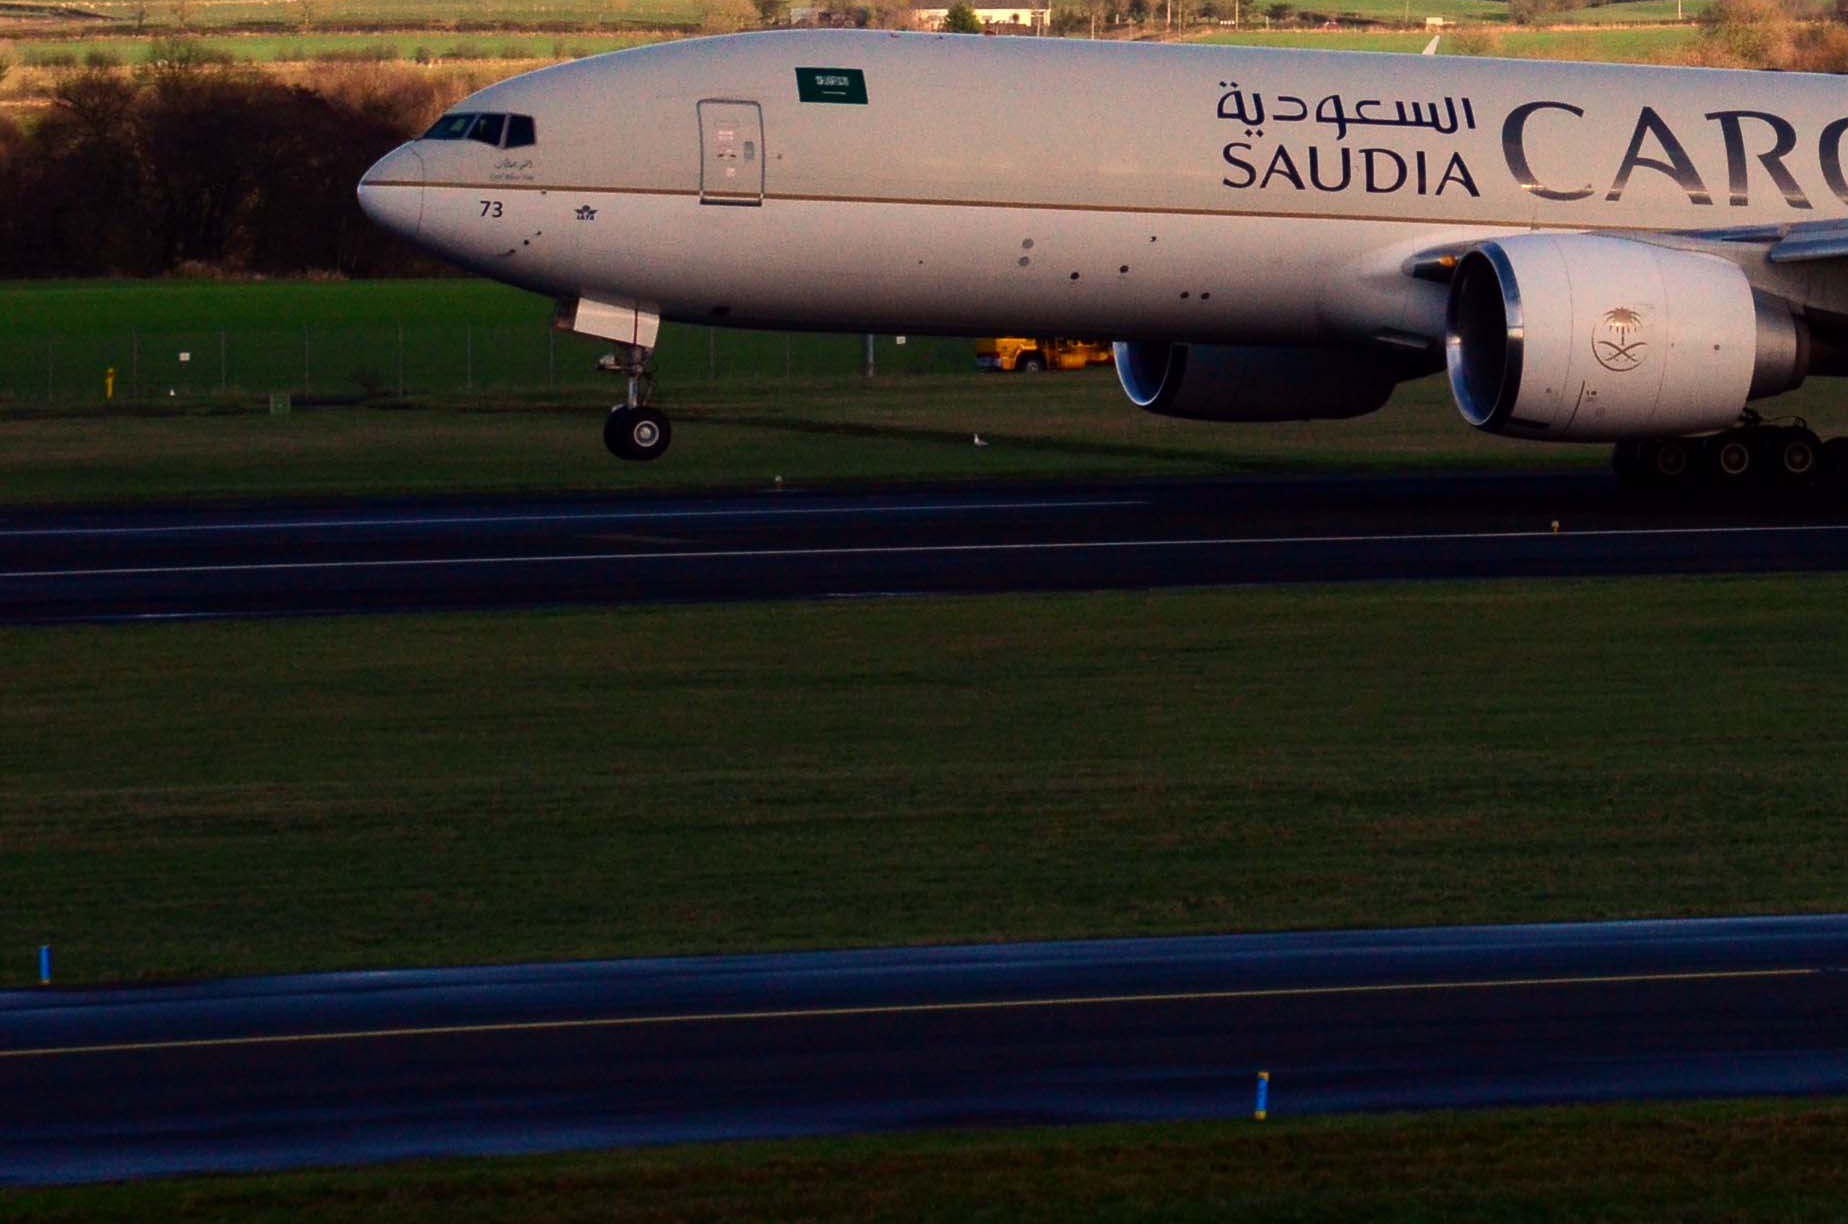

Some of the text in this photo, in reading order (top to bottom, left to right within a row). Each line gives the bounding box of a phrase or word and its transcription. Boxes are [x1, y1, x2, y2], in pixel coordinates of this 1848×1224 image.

[1217, 81, 1476, 140] السعودية
[1223, 142, 1481, 197] SAUDIA
[480, 200, 503, 218] 73
